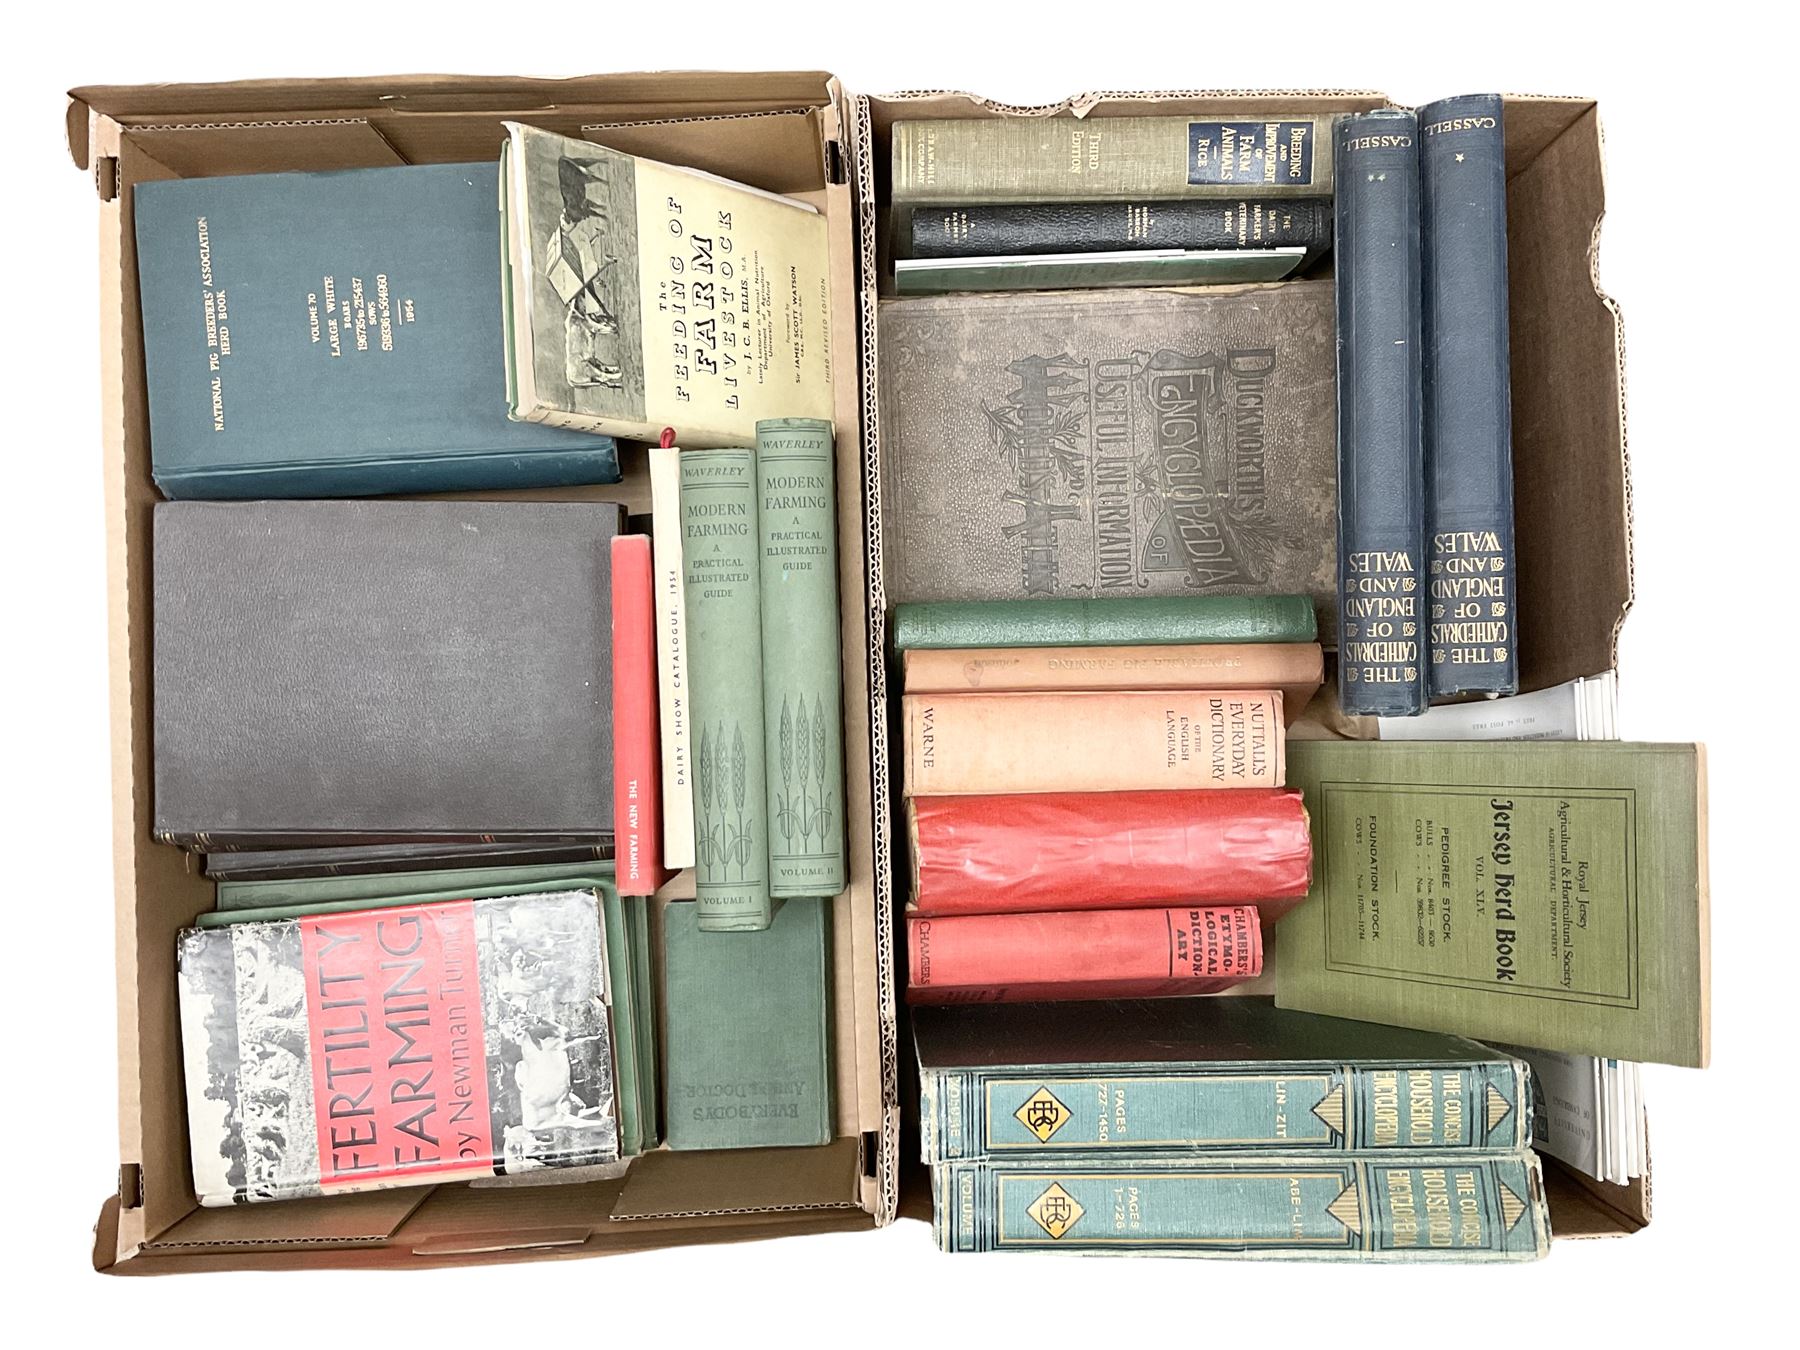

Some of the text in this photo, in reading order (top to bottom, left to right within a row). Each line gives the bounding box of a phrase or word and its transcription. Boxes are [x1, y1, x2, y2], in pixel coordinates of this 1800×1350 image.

[1424, 117, 1496, 136] CASSELL
[1070, 131, 1084, 175] EDITION
[1088, 132, 1102, 170] THIRD
[1198, 138, 1210, 168] RICE
[1222, 126, 1238, 181] ANIMALS
[1239, 136, 1254, 172] FARM
[1256, 148, 1263, 160] OF
[1264, 123, 1280, 183] IMPROVEMENT
[1280, 144, 1288, 162] AND
[1289, 128, 1306, 178] BREEDING
[1343, 136, 1412, 152] CASSELL
[1224, 210, 1232, 234] BOOK
[1237, 202, 1246, 246] VETERINARY
[1267, 210, 1276, 234] DAIRY
[1282, 214, 1291, 232] THE
[198, 216, 213, 287] ASSOCIATION
[659, 281, 667, 312] The
[666, 196, 690, 402] FEEDING OF
[790, 266, 798, 306] WATSON
[820, 278, 828, 314] EDITION
[324, 276, 342, 356] LARGE WHITE
[342, 300, 352, 329] BOARS
[368, 302, 378, 326] SOWS
[690, 234, 717, 376] FARM
[717, 210, 738, 410] LIVESTOCK
[217, 290, 231, 356] HERD BOOK
[309, 306, 320, 343] VOLUME
[792, 310, 800, 338] SCOTT
[210, 354, 220, 372] PIG
[793, 342, 801, 370] JAMES
[212, 378, 224, 432] NATIONAL
[763, 440, 824, 450] WAVERLEY
[684, 467, 745, 477] WAVERLEY
[766, 476, 824, 490] MODERN
[1094, 357, 1144, 589] USEFUL INFORMATION
[688, 504, 746, 518] MODERN
[766, 496, 826, 510] FARMING
[688, 524, 748, 538] FARMING
[792, 516, 800, 525] A
[713, 544, 720, 552] A
[766, 546, 828, 556] ILLUSTRATED
[771, 531, 822, 541] PRACTICAL
[1151, 536, 1168, 565] OF
[1434, 532, 1503, 553] WALES
[688, 569, 749, 584] ILLUSTRATED
[692, 558, 744, 569] PRACTICAL
[782, 562, 813, 571] GUIDE
[1350, 552, 1414, 572] WALES
[1446, 558, 1488, 572] AND
[704, 589, 733, 598] GUIDE
[1359, 578, 1400, 593] AND
[1431, 576, 1505, 598] ENGLAND
[1346, 597, 1416, 618] ENGLAND
[1454, 602, 1481, 618] OF
[1367, 622, 1392, 638] OF
[1431, 622, 1508, 644] CATHEDRALS
[1048, 658, 1116, 670] FARMING
[1346, 642, 1417, 663] CATHEDRALS
[1451, 648, 1490, 664] THE
[1364, 668, 1401, 683] THE
[923, 708, 934, 768] WARNE
[1166, 710, 1176, 768] LANGUAGE
[1180, 716, 1189, 761] ENGLISH
[1194, 724, 1200, 734] OF
[1210, 698, 1224, 782] DICTIONARY
[1230, 702, 1245, 778] EVERYDAY
[1250, 702, 1266, 776] NUTTALL'S
[630, 780, 639, 880] THE NEW FARMING
[780, 867, 834, 876] VOLUME II
[1369, 815, 1380, 942] FOUNDATION STOCK.
[1476, 856, 1484, 882] VOL.
[1442, 827, 1451, 942] PEDIGREE STOCK.
[1490, 798, 1516, 982] Jersey Herd Book
[1556, 800, 1574, 989] Agricultural & Horticultural Society
[1575, 861, 1590, 930] Royal Jersey
[703, 896, 744, 905] VOLUME
[920, 922, 930, 984] CHAMBERS
[1177, 929, 1188, 961] ARY
[1205, 911, 1218, 974] LOGICAL
[314, 924, 380, 1178] FERTILITY
[376, 914, 442, 1170] FARMING
[446, 1002, 476, 1126] Newman
[1099, 1084, 1108, 1142] 727-1450
[1116, 1088, 1127, 1133] PAGES
[1408, 1070, 1434, 1144] HOUSEHOLD
[1442, 1072, 1462, 1144] THE CONCISE
[962, 1172, 974, 1236] VOLUME
[1128, 1187, 1141, 1229] PAGES
[1422, 1169, 1452, 1247] HOUSEHOLD
[1456, 1170, 1482, 1246] THE CONCISE
